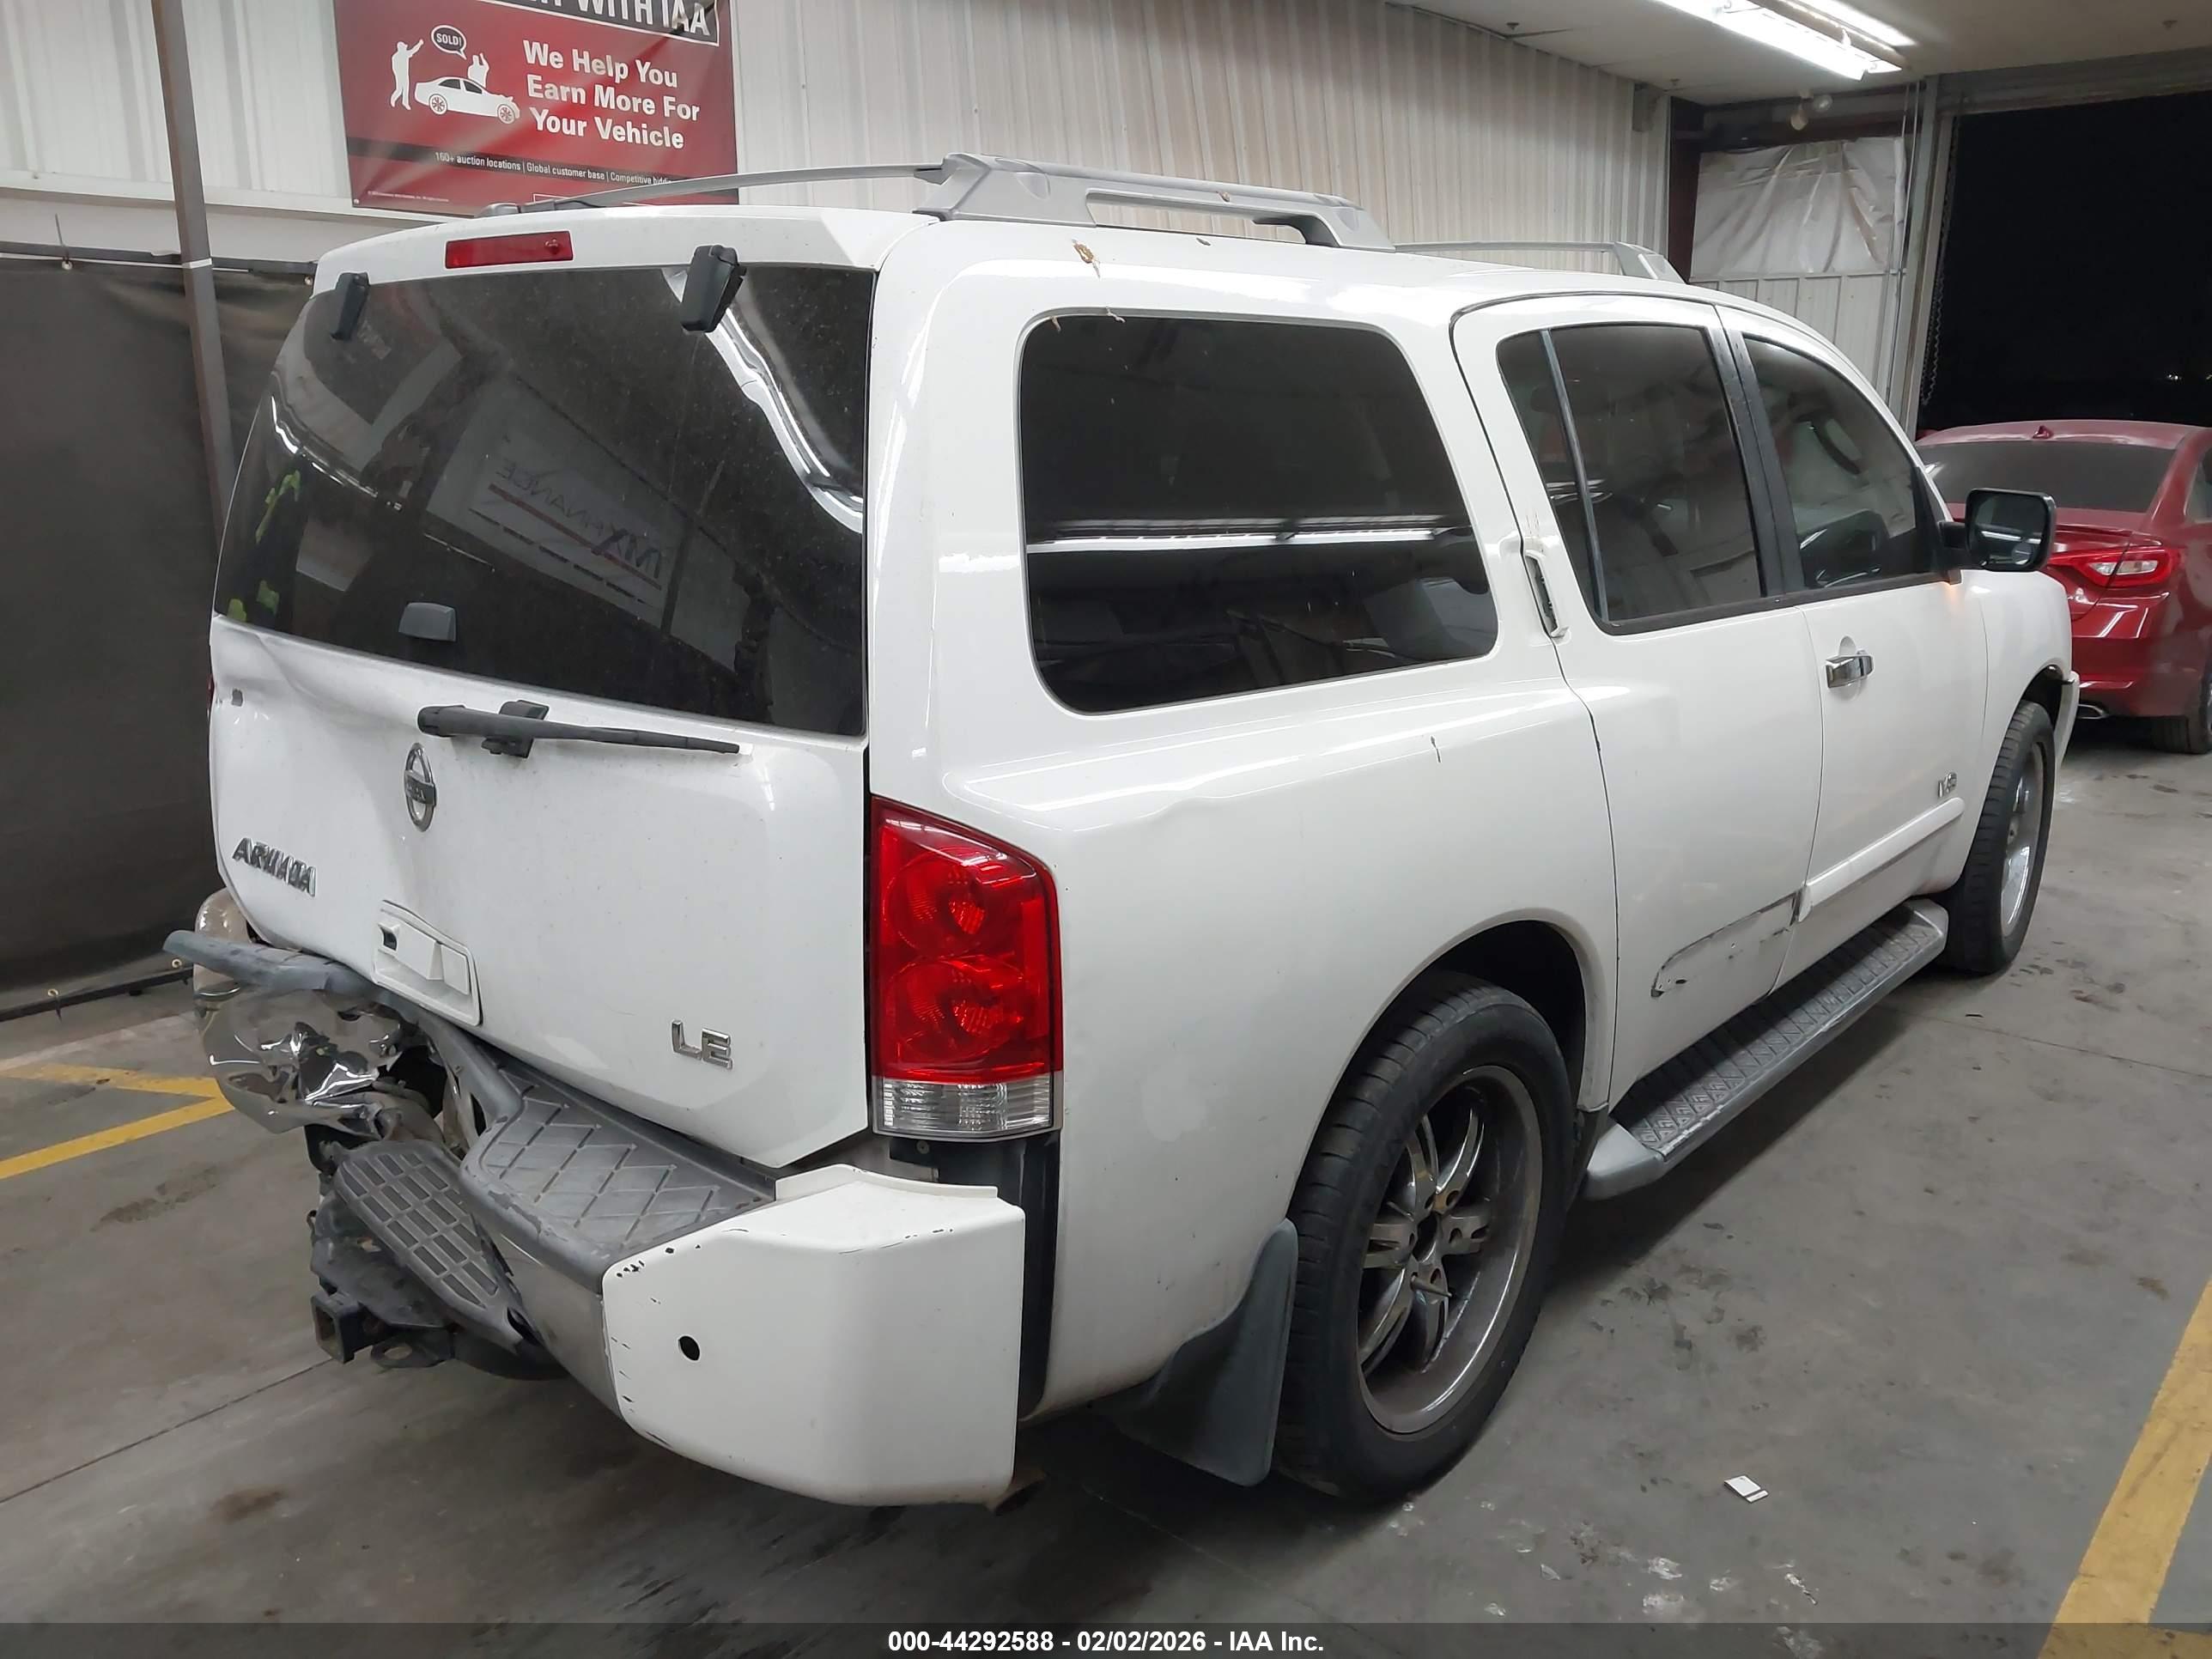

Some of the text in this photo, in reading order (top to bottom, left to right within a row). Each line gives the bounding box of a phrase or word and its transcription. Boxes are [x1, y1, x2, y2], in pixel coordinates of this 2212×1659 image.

[436, 33, 462, 47] SOLD!
[662, 0, 710, 35] IAA
[523, 40, 678, 88] We Help You
[526, 74, 700, 121] Earn More For
[529, 106, 684, 149] Your Vehicle
[435, 151, 454, 163] 160+
[457, 155, 485, 167] auction
[486, 157, 521, 171] locations
[526, 161, 550, 174] Global
[552, 167, 586, 179] customer
[587, 170, 605, 180] base
[611, 172, 652, 185] Competitive
[232, 837, 316, 897] ARMADA
[672, 1020, 732, 1070] LE
